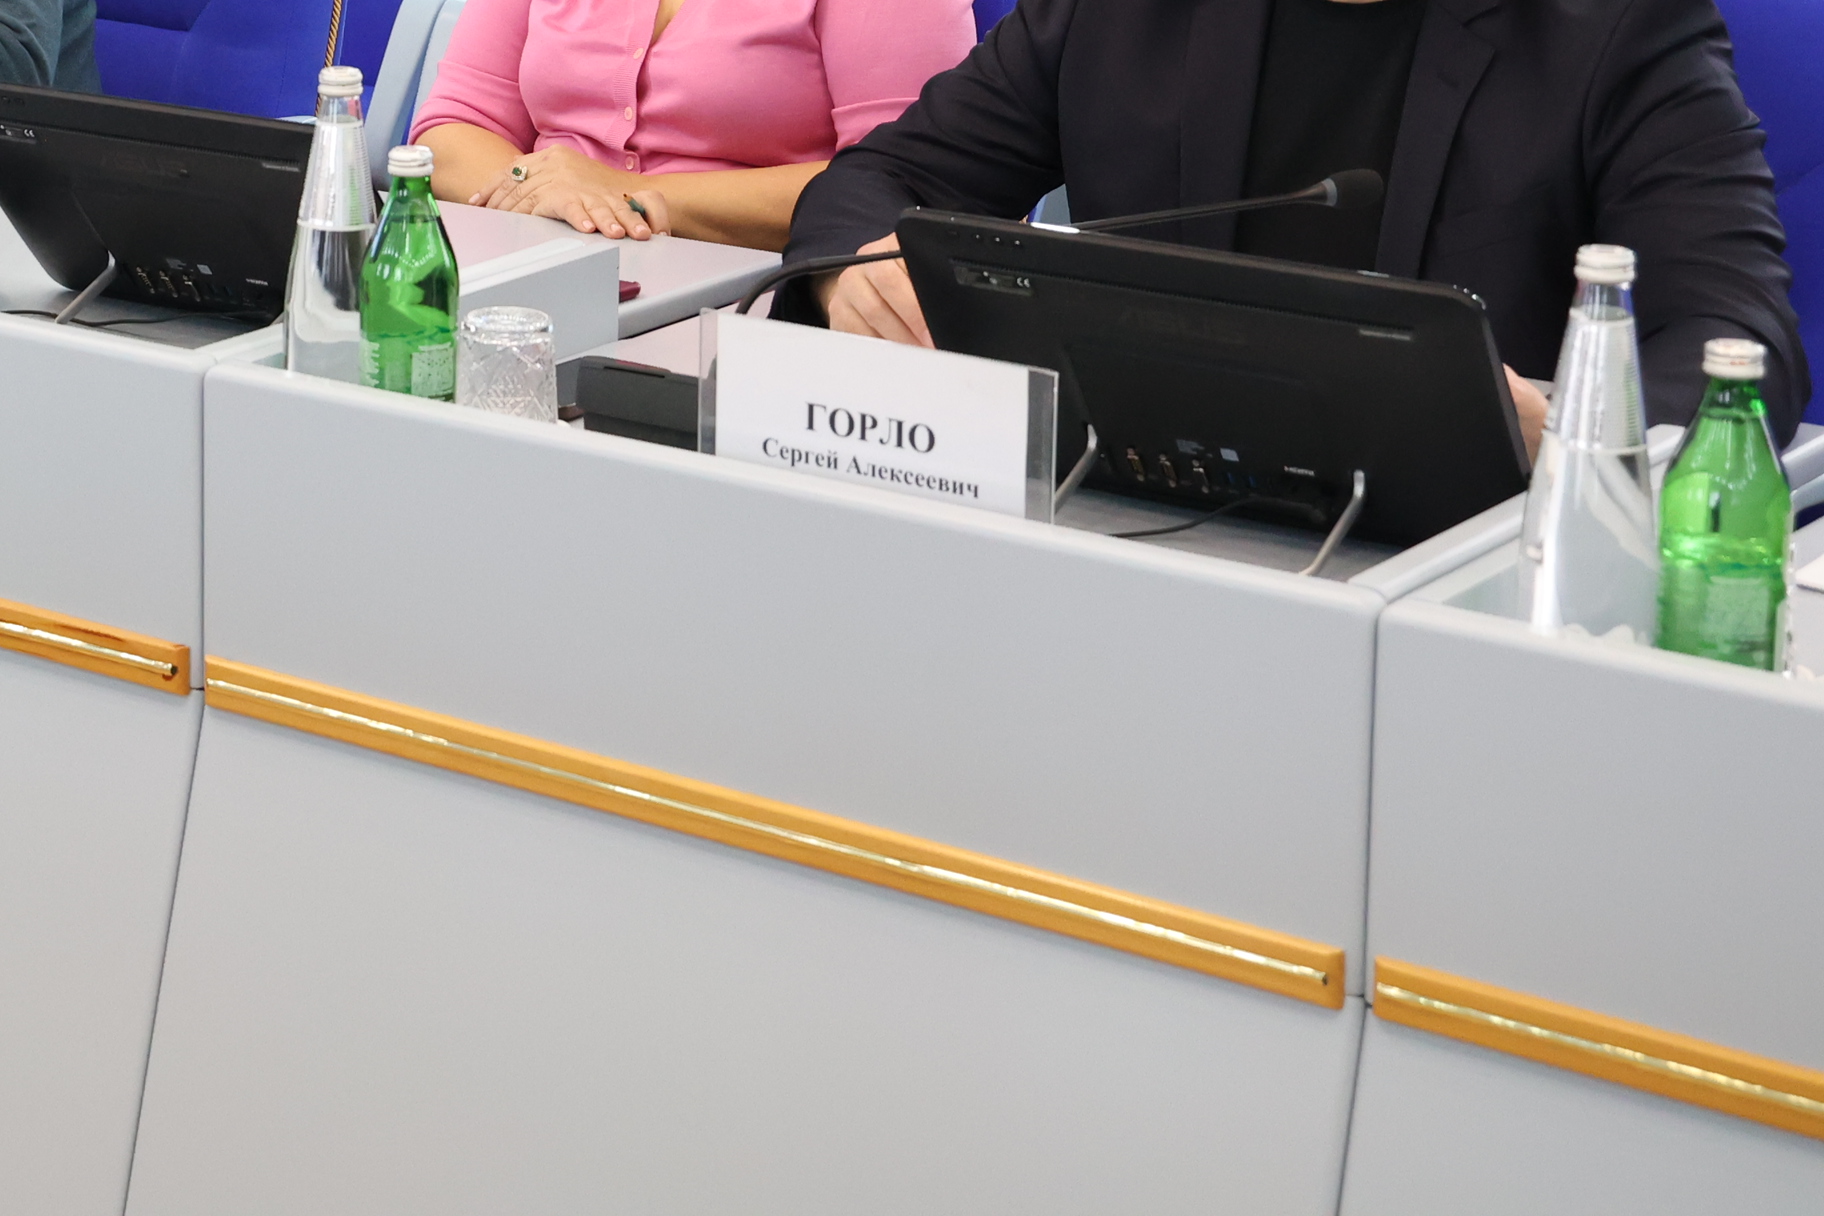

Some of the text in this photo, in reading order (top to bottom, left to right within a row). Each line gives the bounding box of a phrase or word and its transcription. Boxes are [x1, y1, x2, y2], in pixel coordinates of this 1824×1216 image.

[805, 401, 936, 454] ГОРЛО
[762, 437, 980, 499] Сергей Алексеевич
